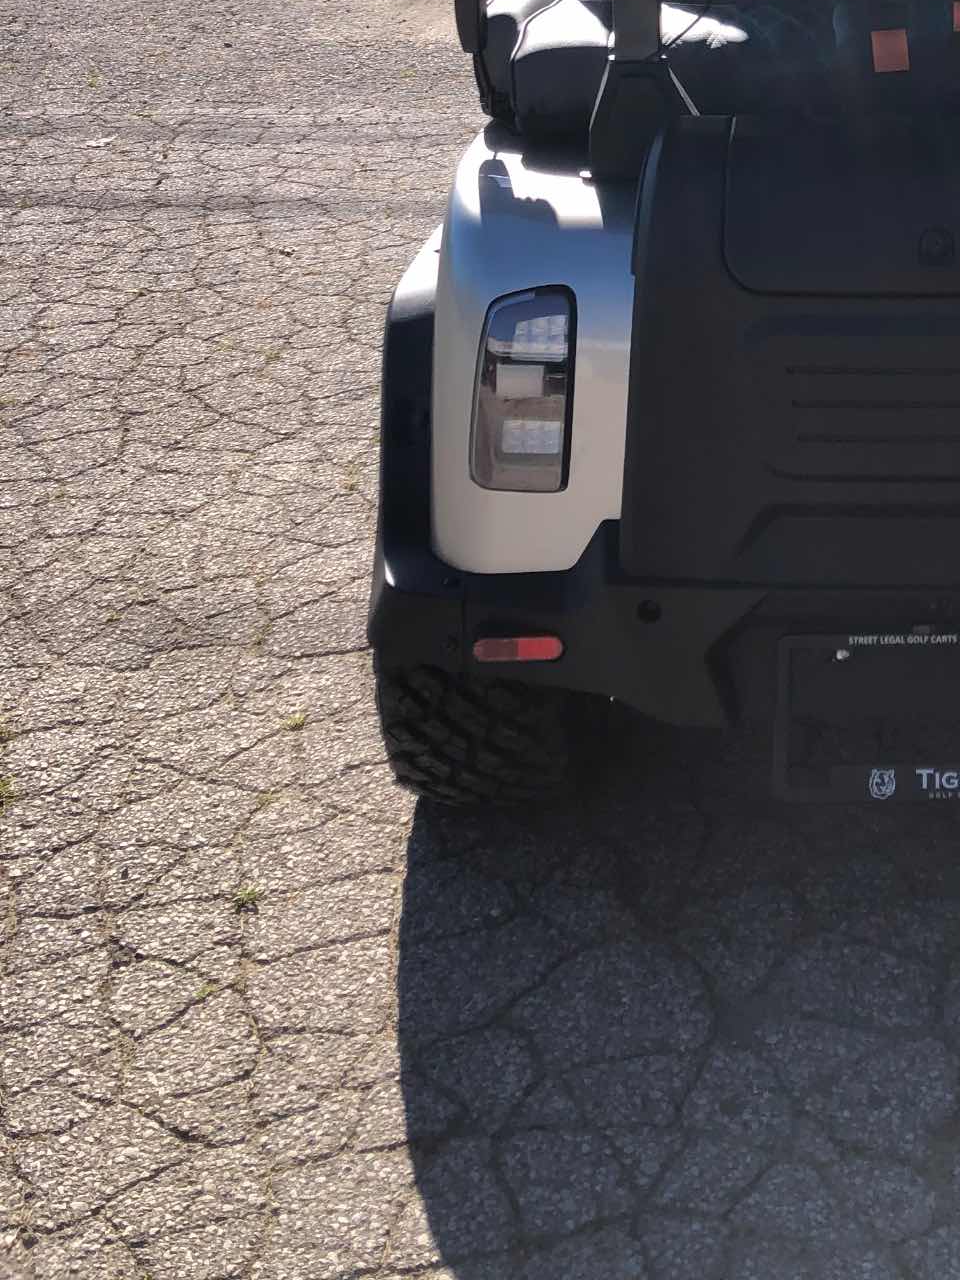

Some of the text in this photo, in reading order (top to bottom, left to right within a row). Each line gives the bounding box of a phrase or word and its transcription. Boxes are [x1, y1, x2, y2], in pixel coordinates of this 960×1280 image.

[849, 634, 878, 645] STREET
[880, 634, 904, 645] LEGAL
[907, 634, 929, 644] GOLF
[930, 634, 957, 644] CARTS
